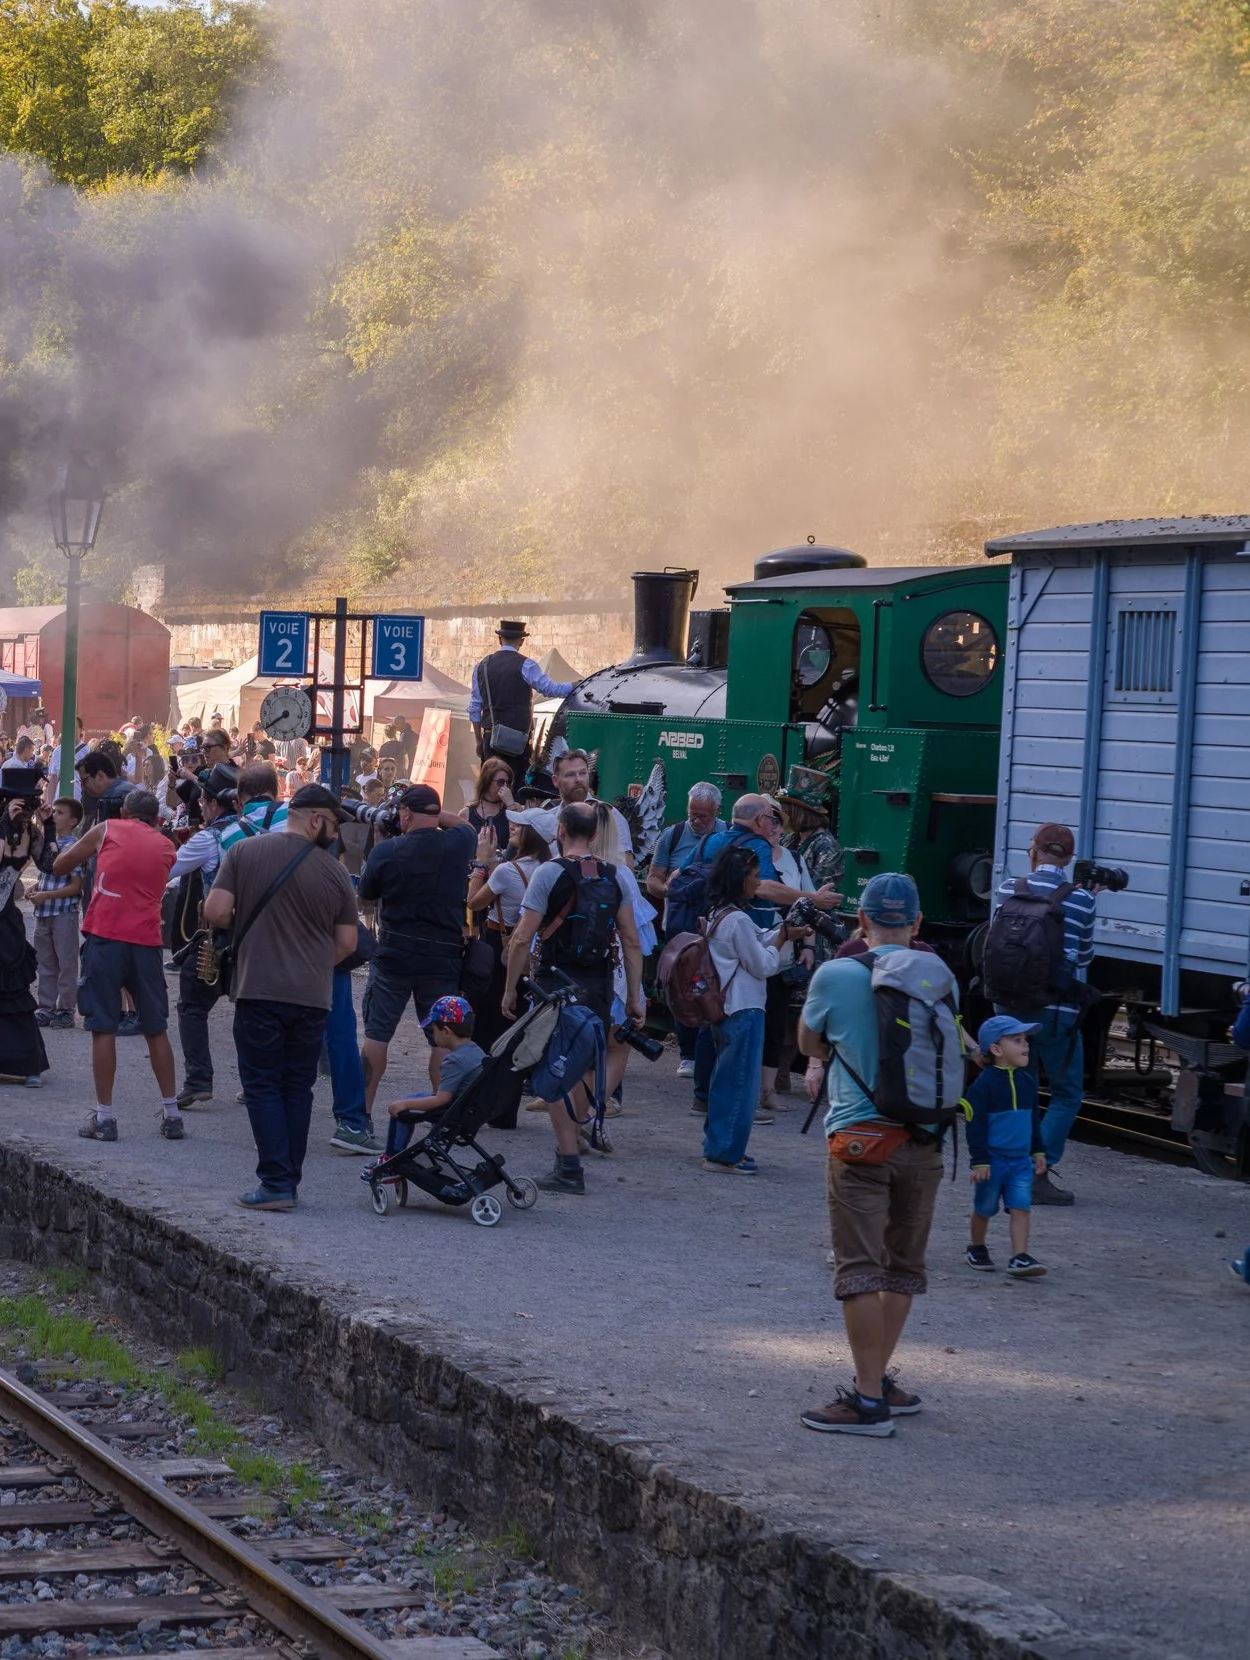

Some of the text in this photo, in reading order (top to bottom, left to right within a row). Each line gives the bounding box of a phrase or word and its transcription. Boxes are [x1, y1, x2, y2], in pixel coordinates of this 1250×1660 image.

[270, 622, 300, 635] VOIE
[383, 626, 414, 638] VOIE
[276, 638, 292, 668] 2
[390, 642, 406, 670] 3
[658, 731, 704, 748] ARBED
[672, 750, 688, 759] BELVAL
